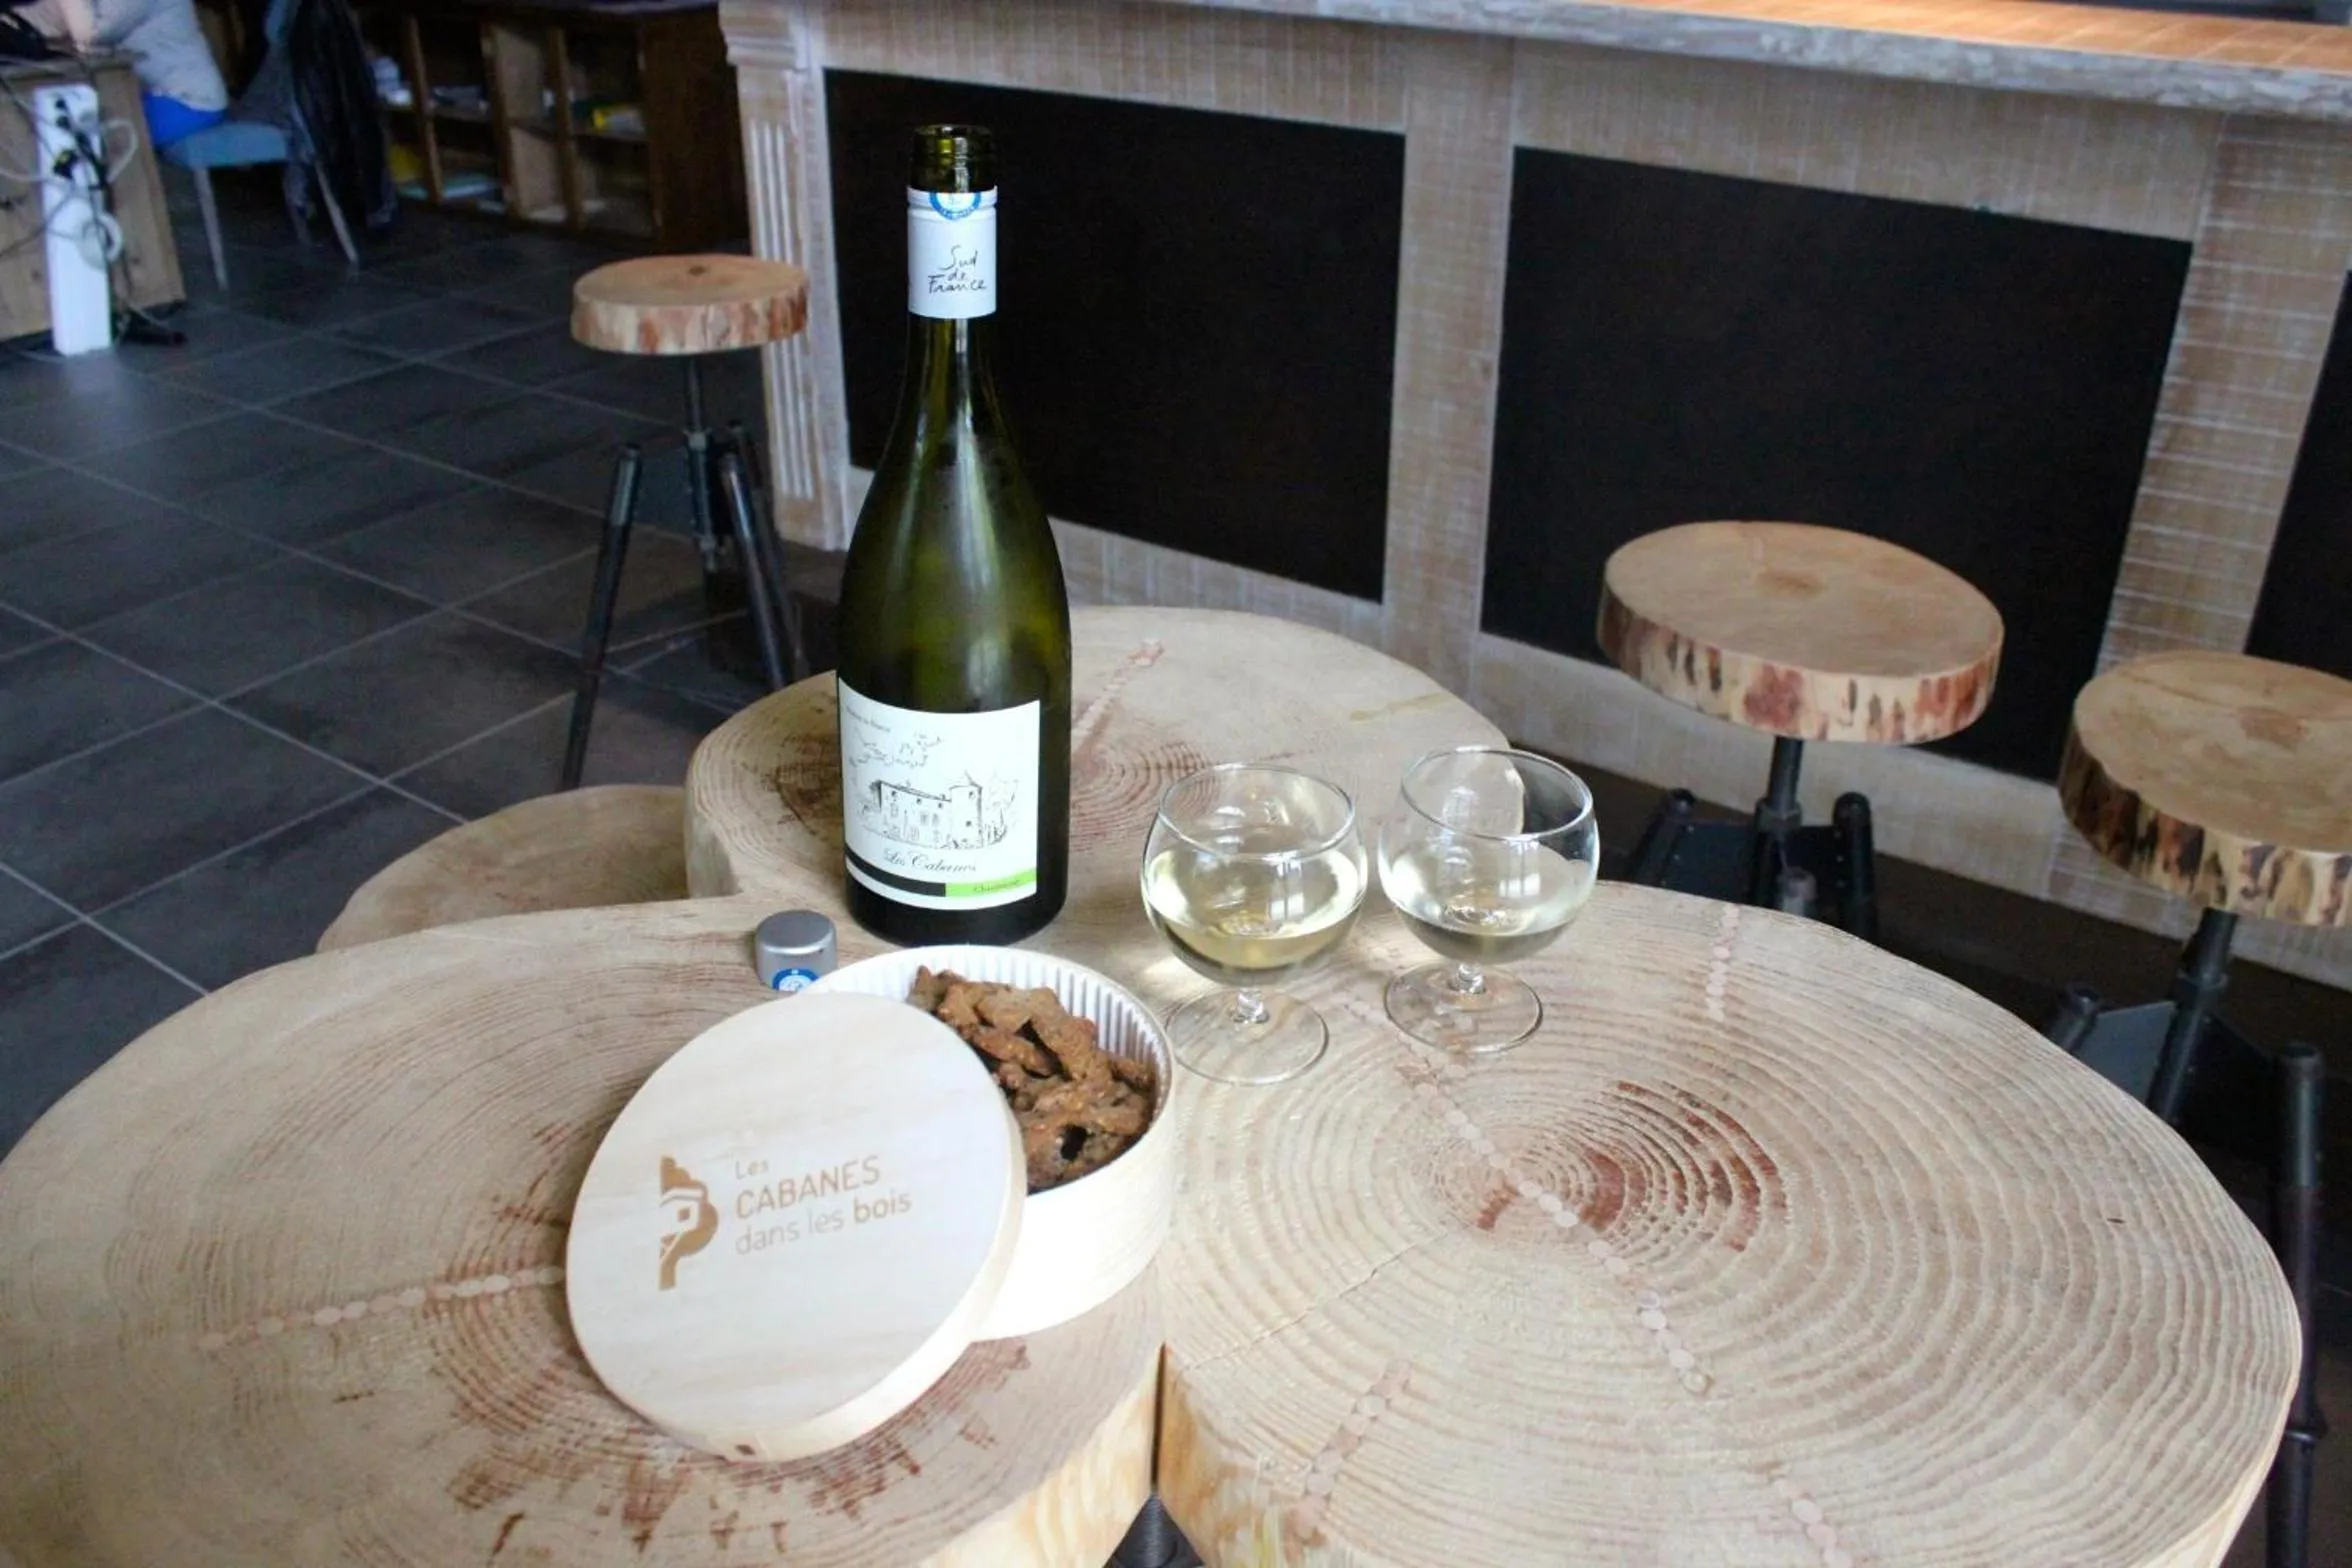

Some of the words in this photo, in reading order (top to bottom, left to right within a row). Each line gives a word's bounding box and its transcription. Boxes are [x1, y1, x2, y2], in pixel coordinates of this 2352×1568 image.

[938, 245, 978, 271] Sud
[928, 274, 987, 294] France
[947, 268, 967, 282] de
[735, 1160, 769, 1180] Les
[735, 1155, 881, 1219] CABANES
[735, 1221, 800, 1255] dans
[808, 1209, 844, 1235] les
[853, 1188, 912, 1224] bois
